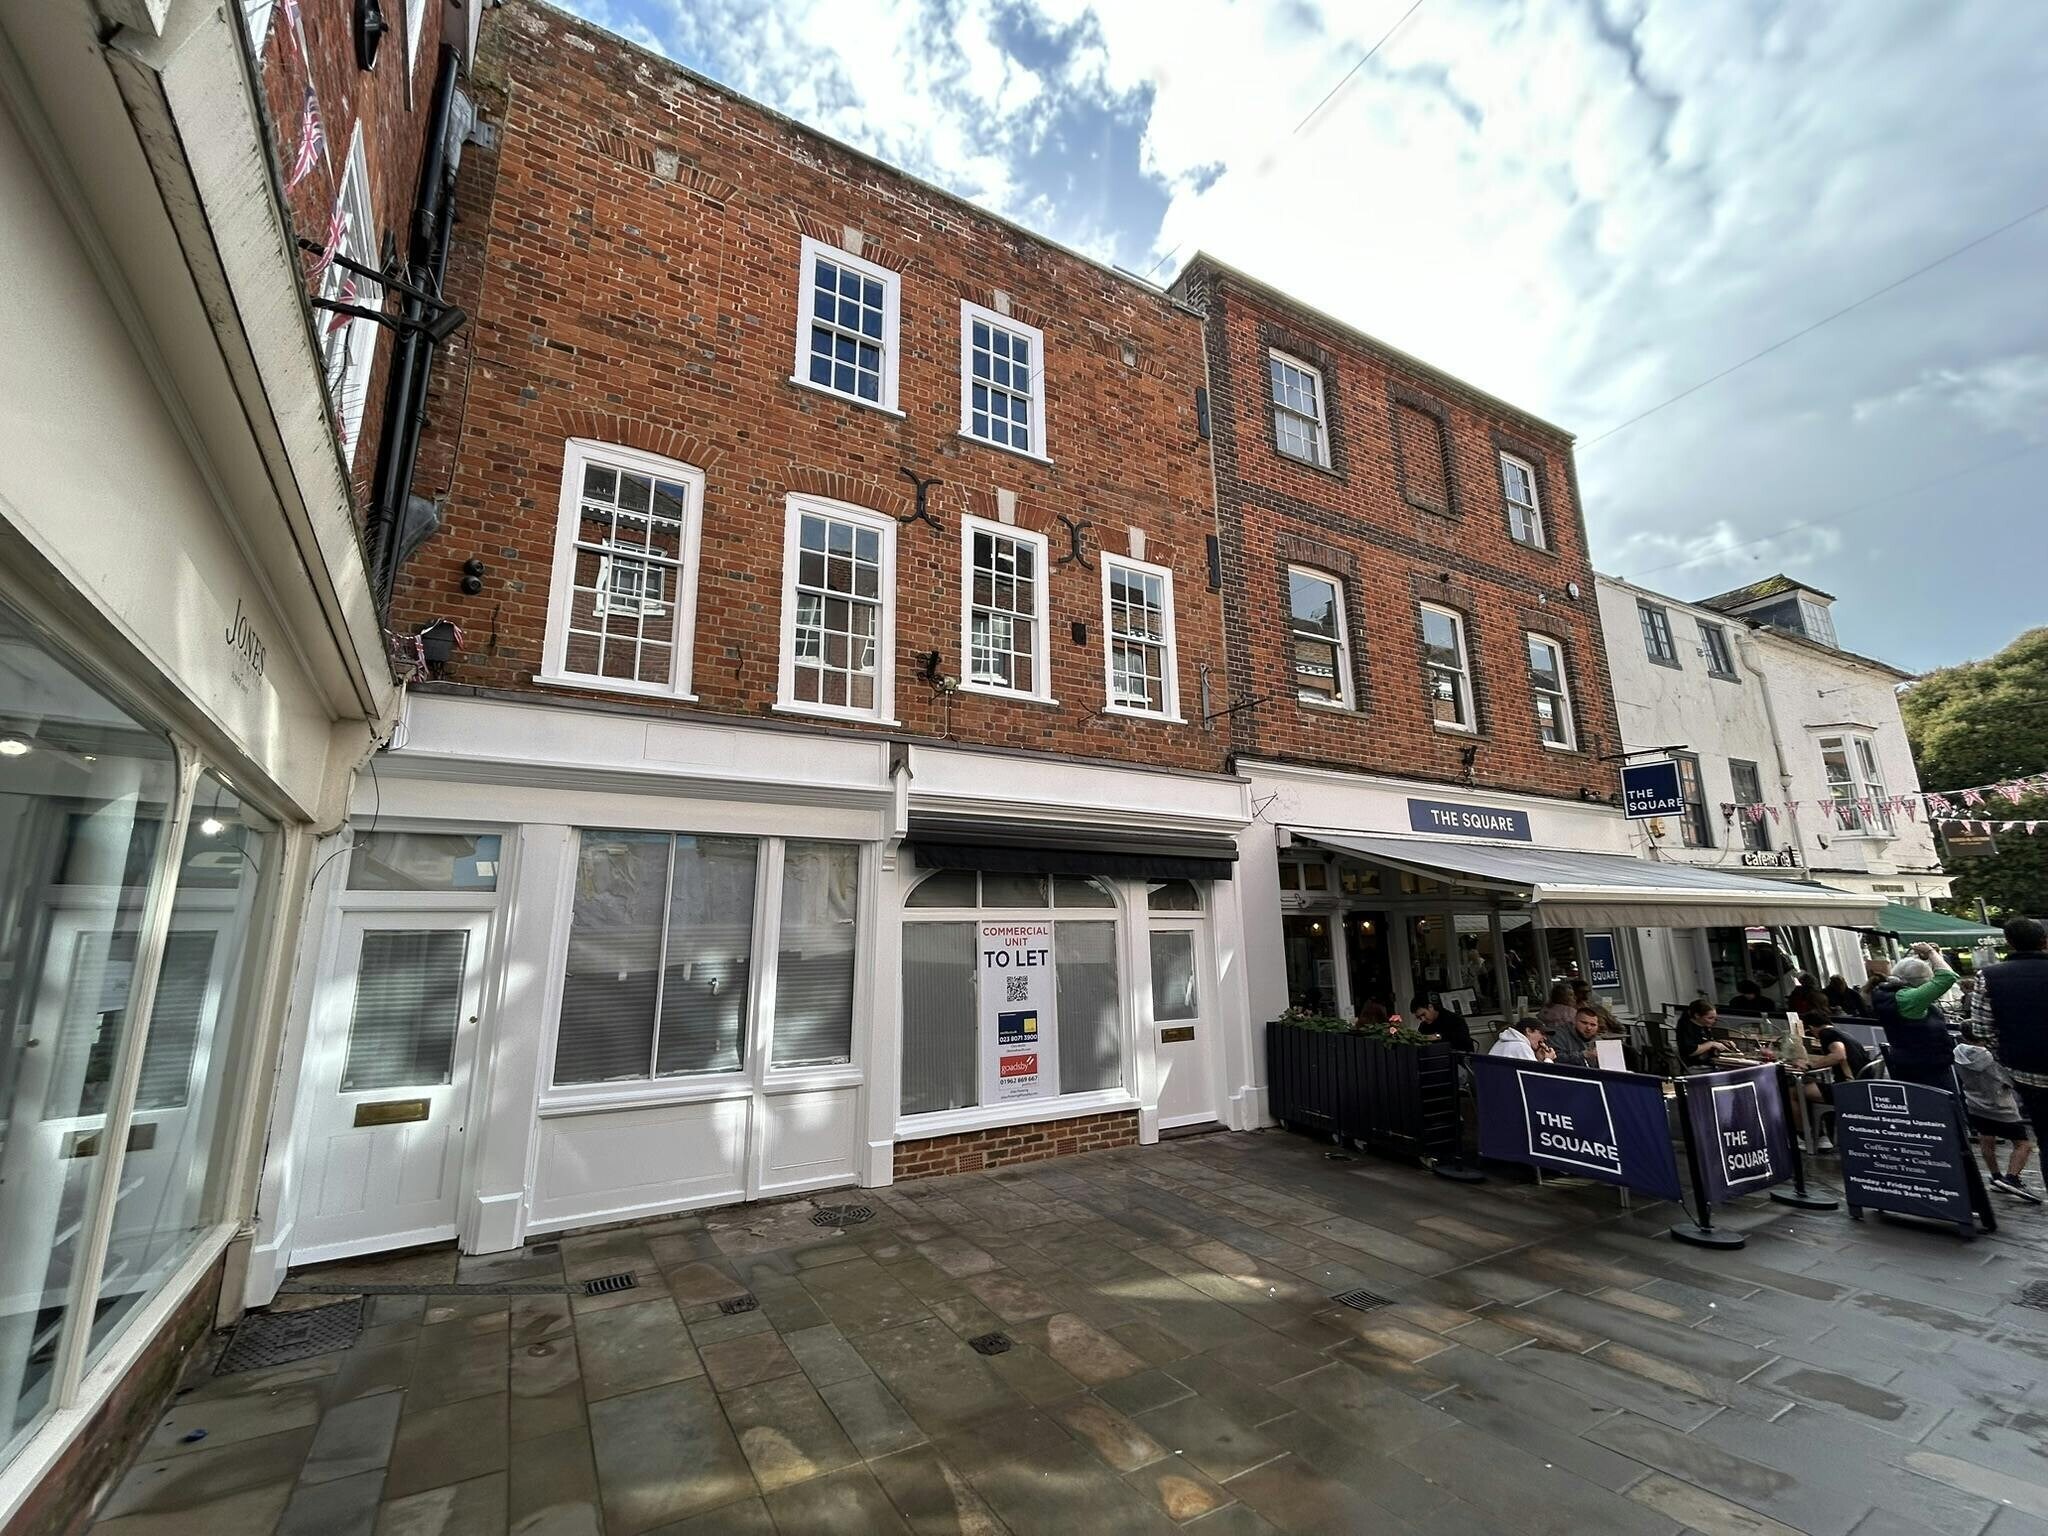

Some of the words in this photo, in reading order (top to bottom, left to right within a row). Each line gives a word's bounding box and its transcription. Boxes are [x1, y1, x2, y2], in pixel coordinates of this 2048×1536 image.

[225, 597, 266, 677] JONES
[1627, 788, 1654, 799] THE
[1629, 797, 1684, 811] SQUARE
[1430, 809, 1460, 827] THE
[1462, 812, 1515, 832] SQUARE
[982, 926, 1048, 937] COMMERCIAL
[1004, 937, 1028, 947] UNIT
[983, 951, 1010, 968] TO
[1015, 949, 1049, 967] LET
[1590, 959, 1604, 969] THE
[1592, 970, 1619, 981] SQUARE
[1001, 1061, 1029, 1074] goadsby
[1874, 1102, 1908, 1111] SQUARE
[1535, 1110, 1574, 1131] THE
[1841, 1112, 1880, 1121] Additional
[1723, 1130, 1748, 1147] THE
[1881, 1129, 1921, 1139] Courtyard
[1922, 1133, 1943, 1141] Area
[1540, 1131, 1620, 1161] SQUARE
[1863, 1142, 1890, 1152] Coffee
[1727, 1148, 1769, 1171] SQUARE
[1849, 1175, 1880, 1186] Monday
